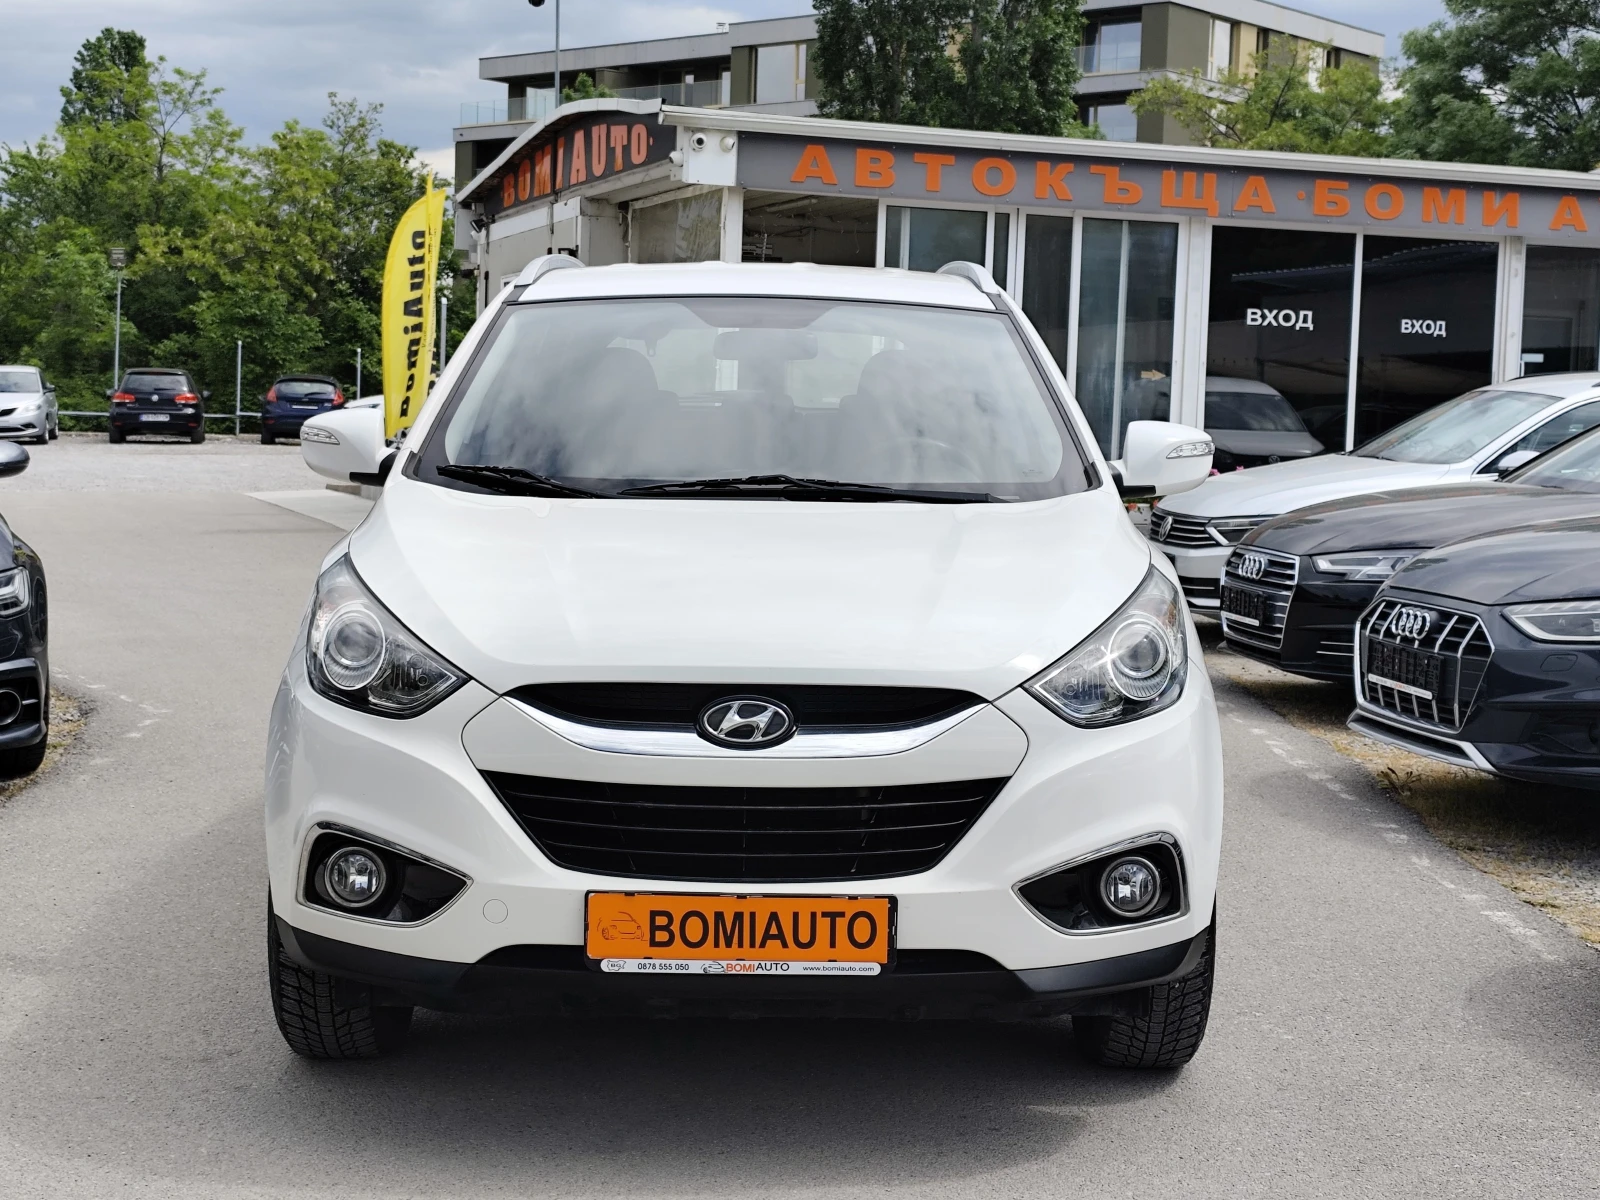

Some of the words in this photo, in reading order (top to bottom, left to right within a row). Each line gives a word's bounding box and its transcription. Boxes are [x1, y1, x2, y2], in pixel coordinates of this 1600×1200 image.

[790, 144, 1276, 218] АВТОКЪЩА
[1312, 179, 1520, 229] БОМИ
[1549, 195, 1600, 232] А
[1246, 308, 1314, 331] ВХОД
[1400, 318, 1447, 338] ВХОД
[649, 909, 878, 949] BOMIAUTO
[637, 962, 657, 971] 0878
[658, 962, 673, 971] 555
[674, 962, 690, 971] 050
[802, 964, 875, 972] www.bomiauto.com
